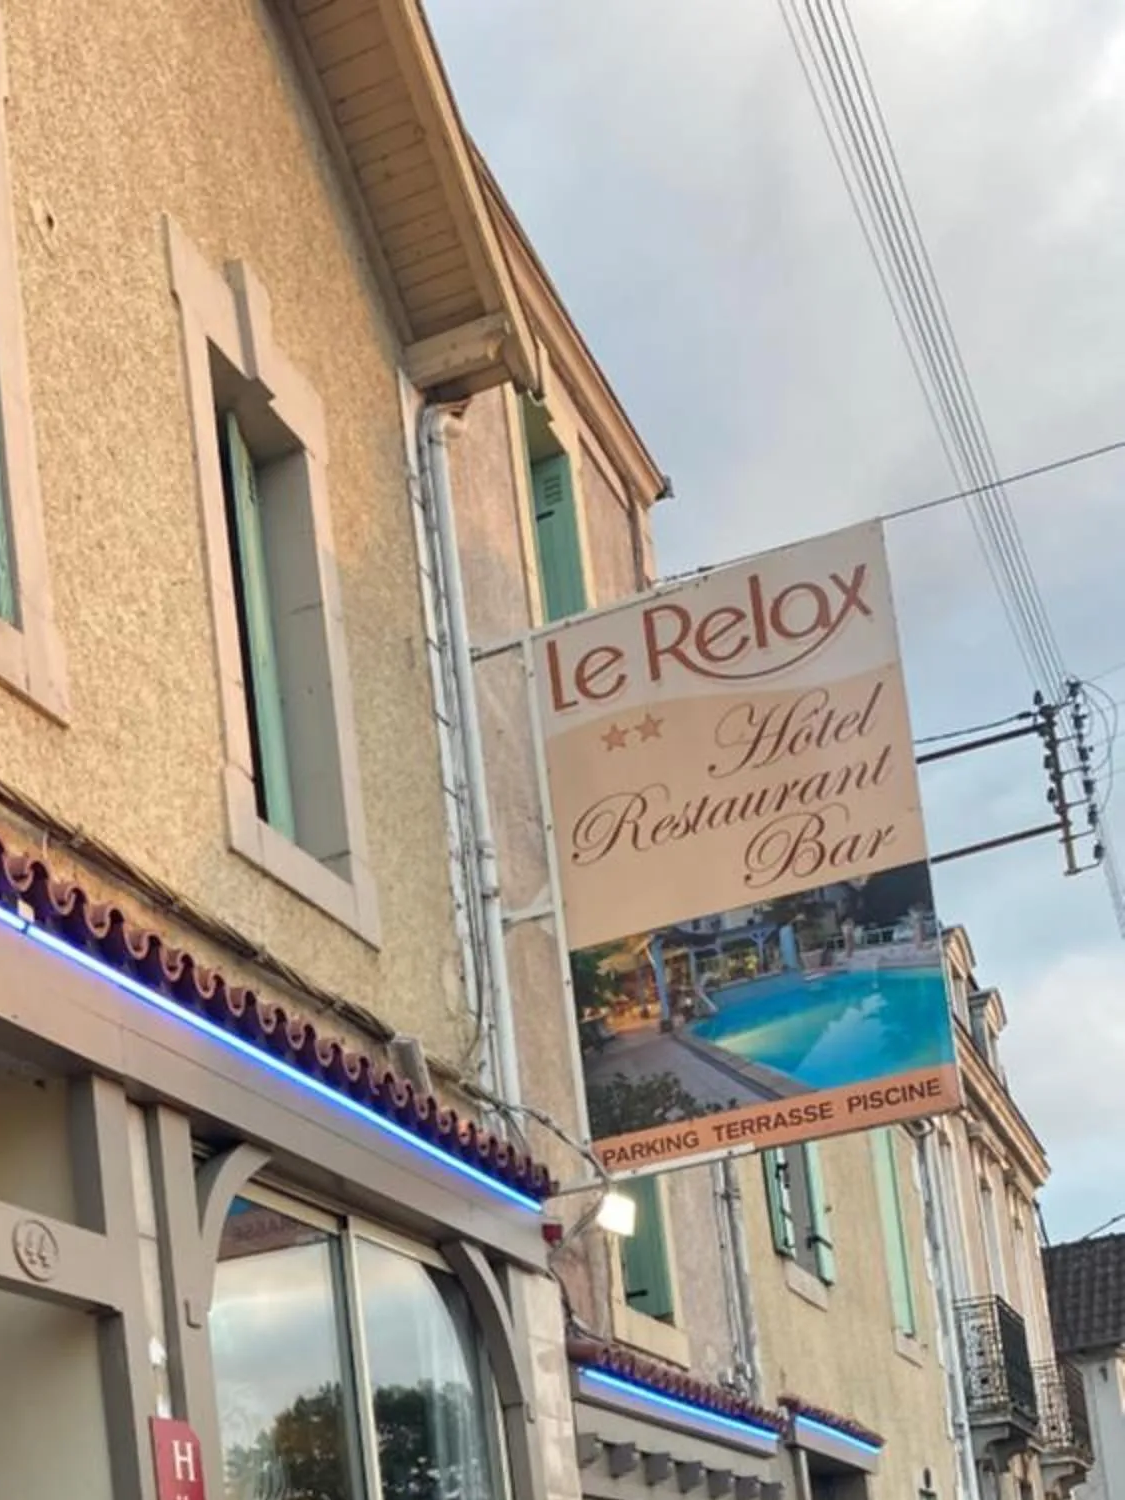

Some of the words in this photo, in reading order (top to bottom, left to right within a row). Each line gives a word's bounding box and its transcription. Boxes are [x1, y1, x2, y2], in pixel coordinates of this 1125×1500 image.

[546, 640, 627, 712] Le
[642, 563, 872, 681] Relax
[707, 681, 884, 779] Hôtel
[571, 744, 892, 867] Restaurant
[744, 802, 895, 889] Bar
[602, 1131, 700, 1168] PARKING
[712, 1101, 834, 1143] TERRASSE
[846, 1077, 942, 1114] PISCINE
[171, 1440, 196, 1482] H
